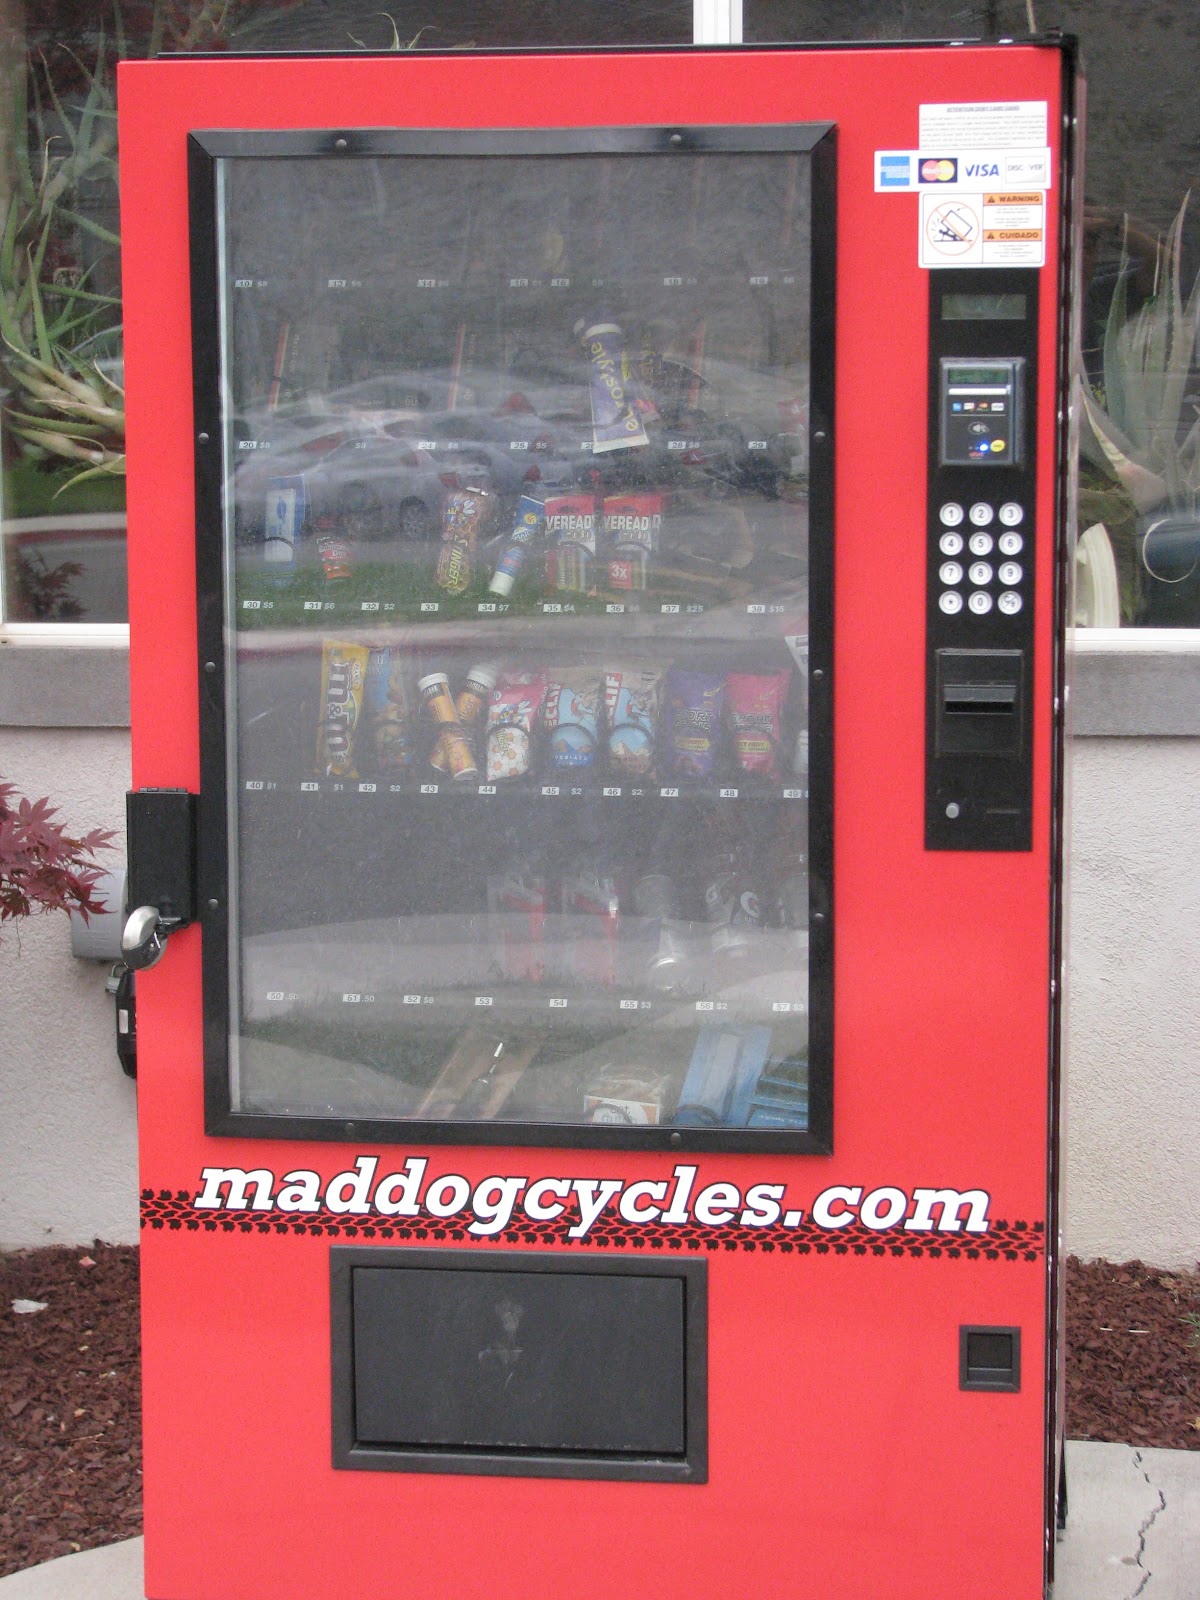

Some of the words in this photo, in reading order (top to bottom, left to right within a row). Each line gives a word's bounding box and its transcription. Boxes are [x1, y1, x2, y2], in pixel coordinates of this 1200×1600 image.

[964, 164, 1000, 177] VISA
[1007, 163, 1043, 172] DISCVER
[998, 195, 1040, 203] WARNING
[998, 232, 1039, 240] CUIDADO
[194, 1155, 991, 1238] maddogcycles.com
